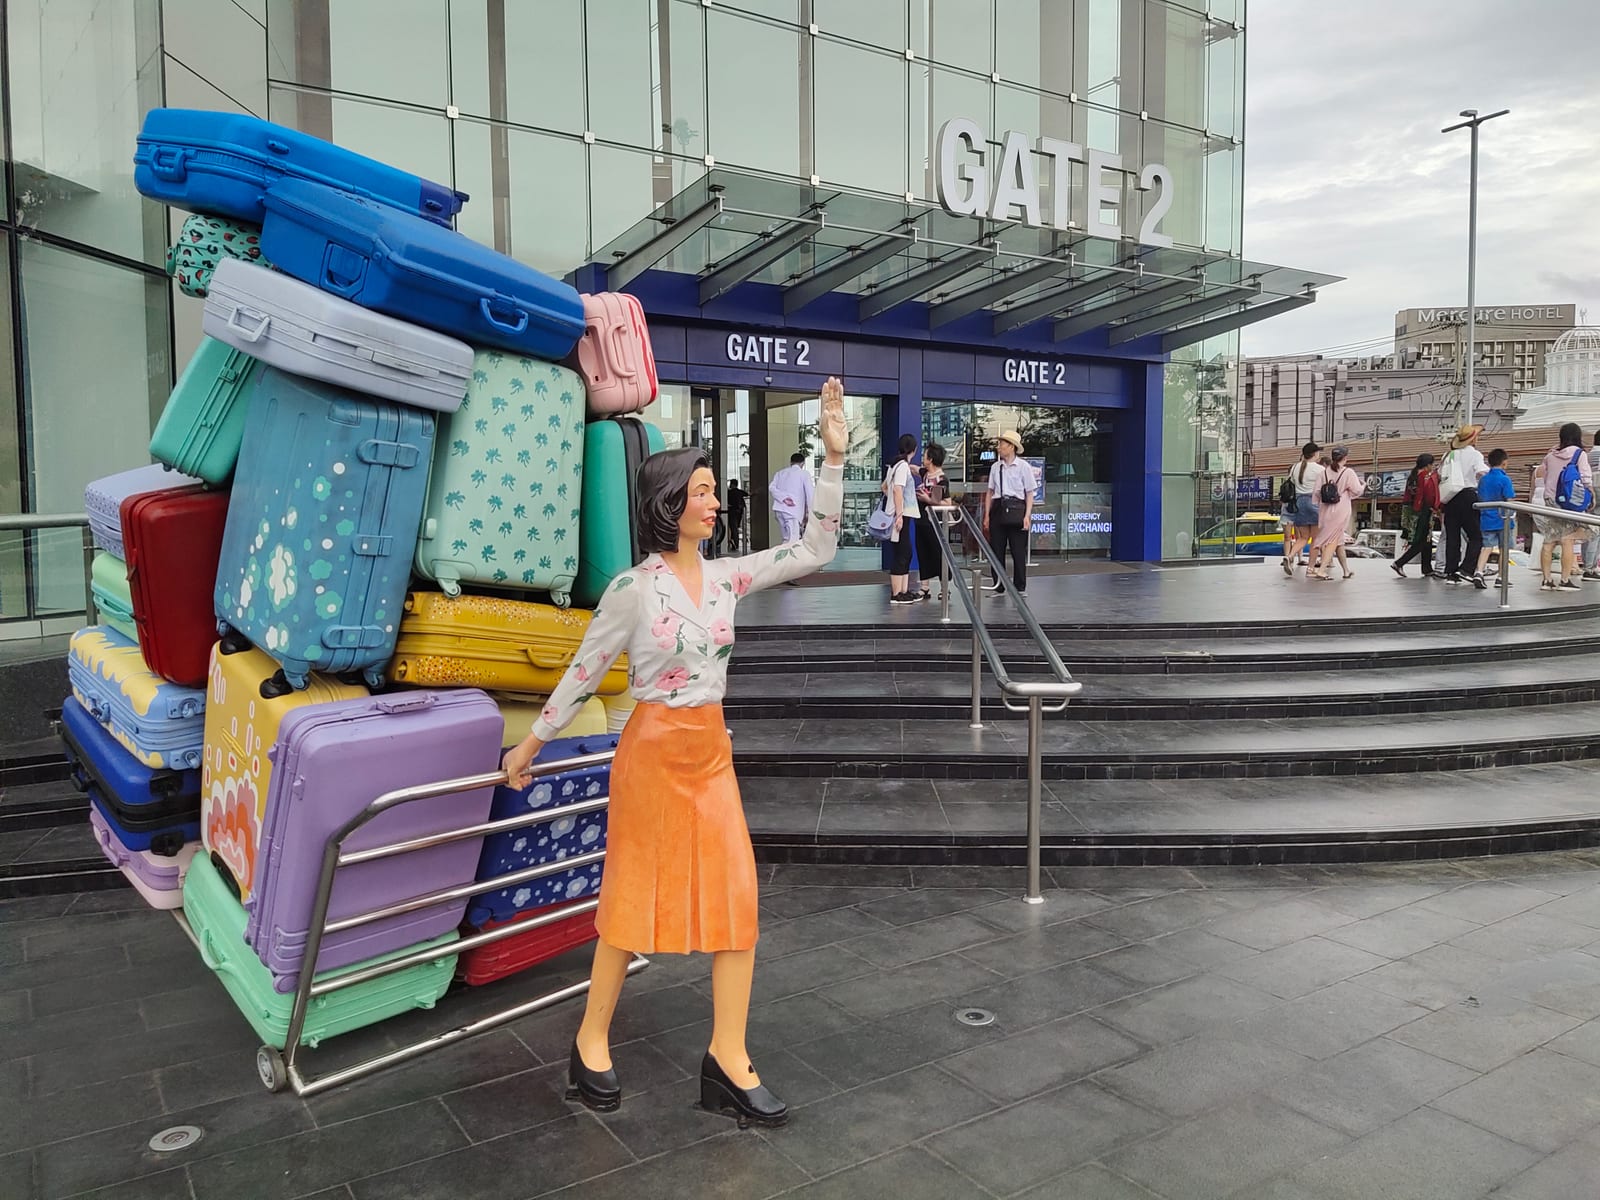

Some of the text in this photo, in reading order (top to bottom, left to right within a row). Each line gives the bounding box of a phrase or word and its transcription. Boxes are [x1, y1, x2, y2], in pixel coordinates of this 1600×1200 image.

[936, 117, 1174, 248] GATE 2
[1511, 307, 1565, 320] HOTEL
[727, 333, 810, 366] GATE 2
[1004, 358, 1066, 385] GATE 2
[980, 451, 995, 461] ATM
[1068, 512, 1101, 521] CURRENCY
